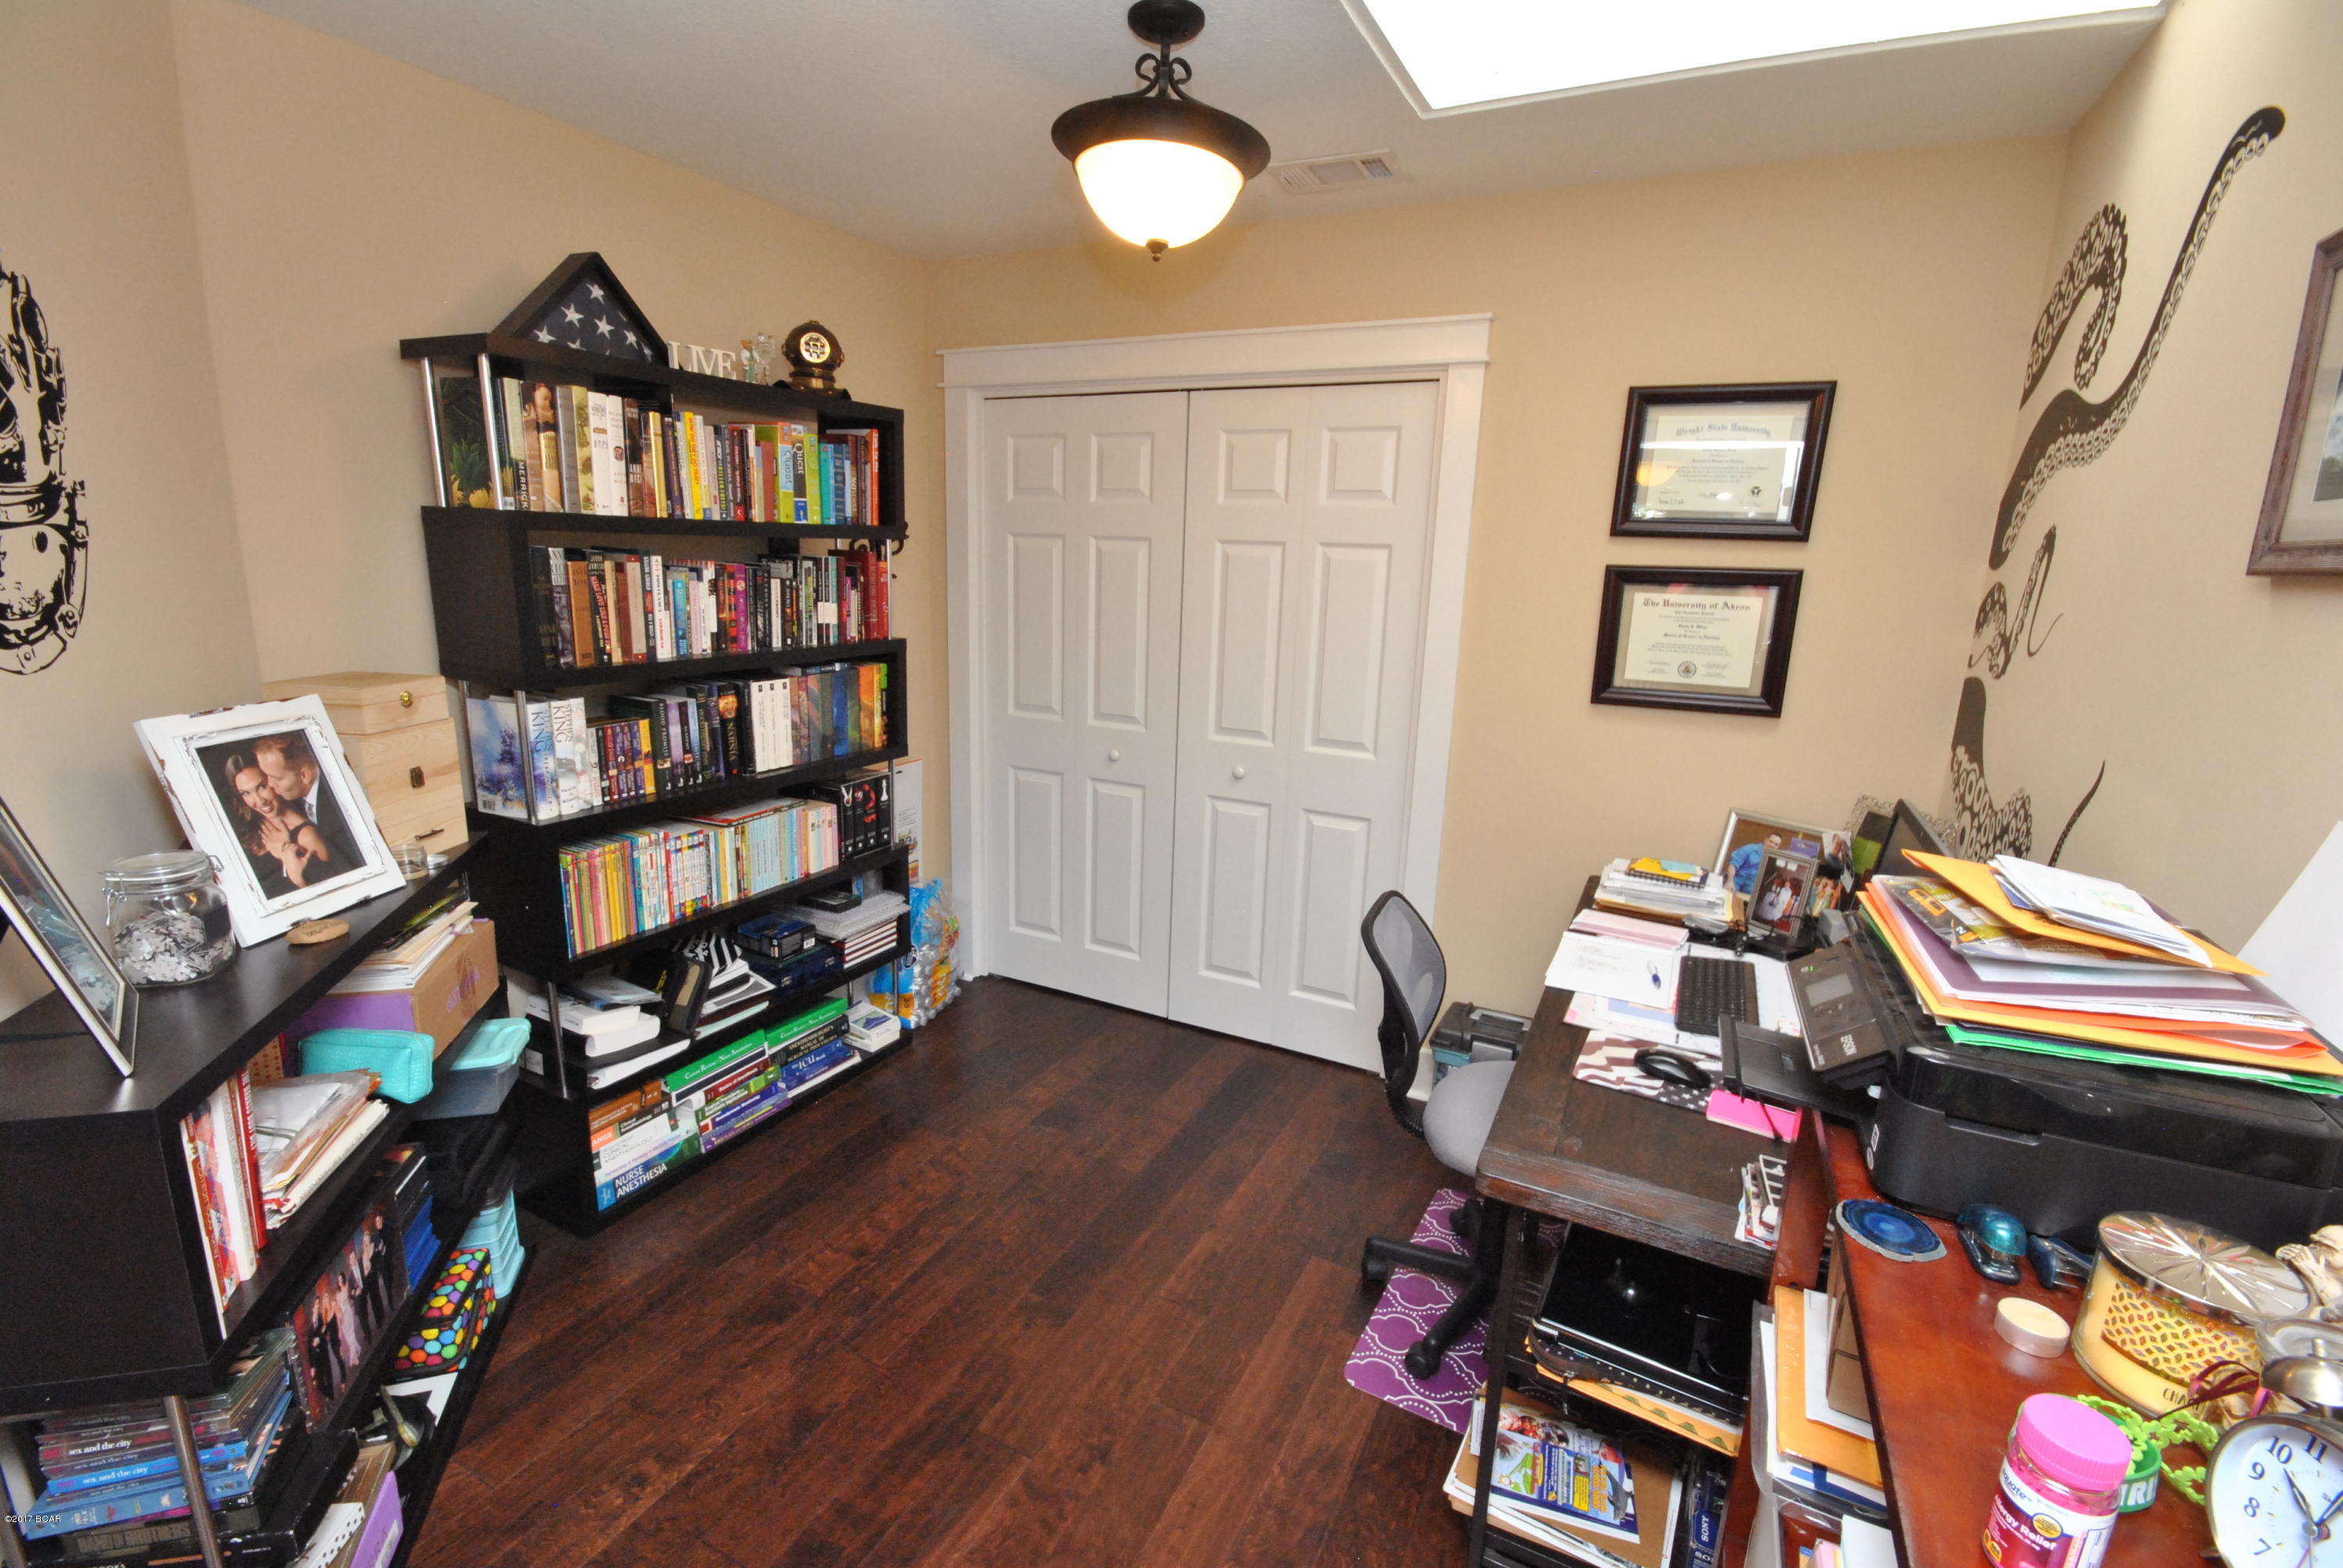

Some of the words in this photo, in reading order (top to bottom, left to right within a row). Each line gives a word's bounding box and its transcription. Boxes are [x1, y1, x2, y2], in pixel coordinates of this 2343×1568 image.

[1707, 422, 1728, 431] State
[1731, 422, 1771, 438] University
[792, 443, 804, 475] Quest
[518, 461, 528, 509] MERRICK
[1643, 597, 1660, 608] The
[1662, 599, 1707, 611] University
[1709, 601, 1719, 610] of
[1721, 600, 1751, 611] Akron
[532, 711, 545, 753] KING
[553, 705, 565, 743] KING
[1840, 1033, 1858, 1057] EPSON
[799, 1055, 815, 1070] ICU
[615, 1164, 644, 1188] NURSE
[616, 1163, 668, 1198] ANESTHESIA
[67, 1445, 84, 1455] sex
[84, 1443, 101, 1454] and
[102, 1440, 116, 1452] the
[116, 1438, 132, 1450] city
[2266, 1435, 2292, 1465] 10
[2304, 1434, 2328, 1464] 11
[83, 1474, 98, 1484] sex
[99, 1470, 118, 1482] and
[119, 1468, 132, 1479] the
[132, 1465, 148, 1477] city
[2248, 1461, 2266, 1481] 9
[2243, 1496, 2260, 1518] 8
[1701, 1514, 1710, 1542] SONY
[2019, 1523, 2057, 1551] Relief
[2253, 1538, 2272, 1556] 7
